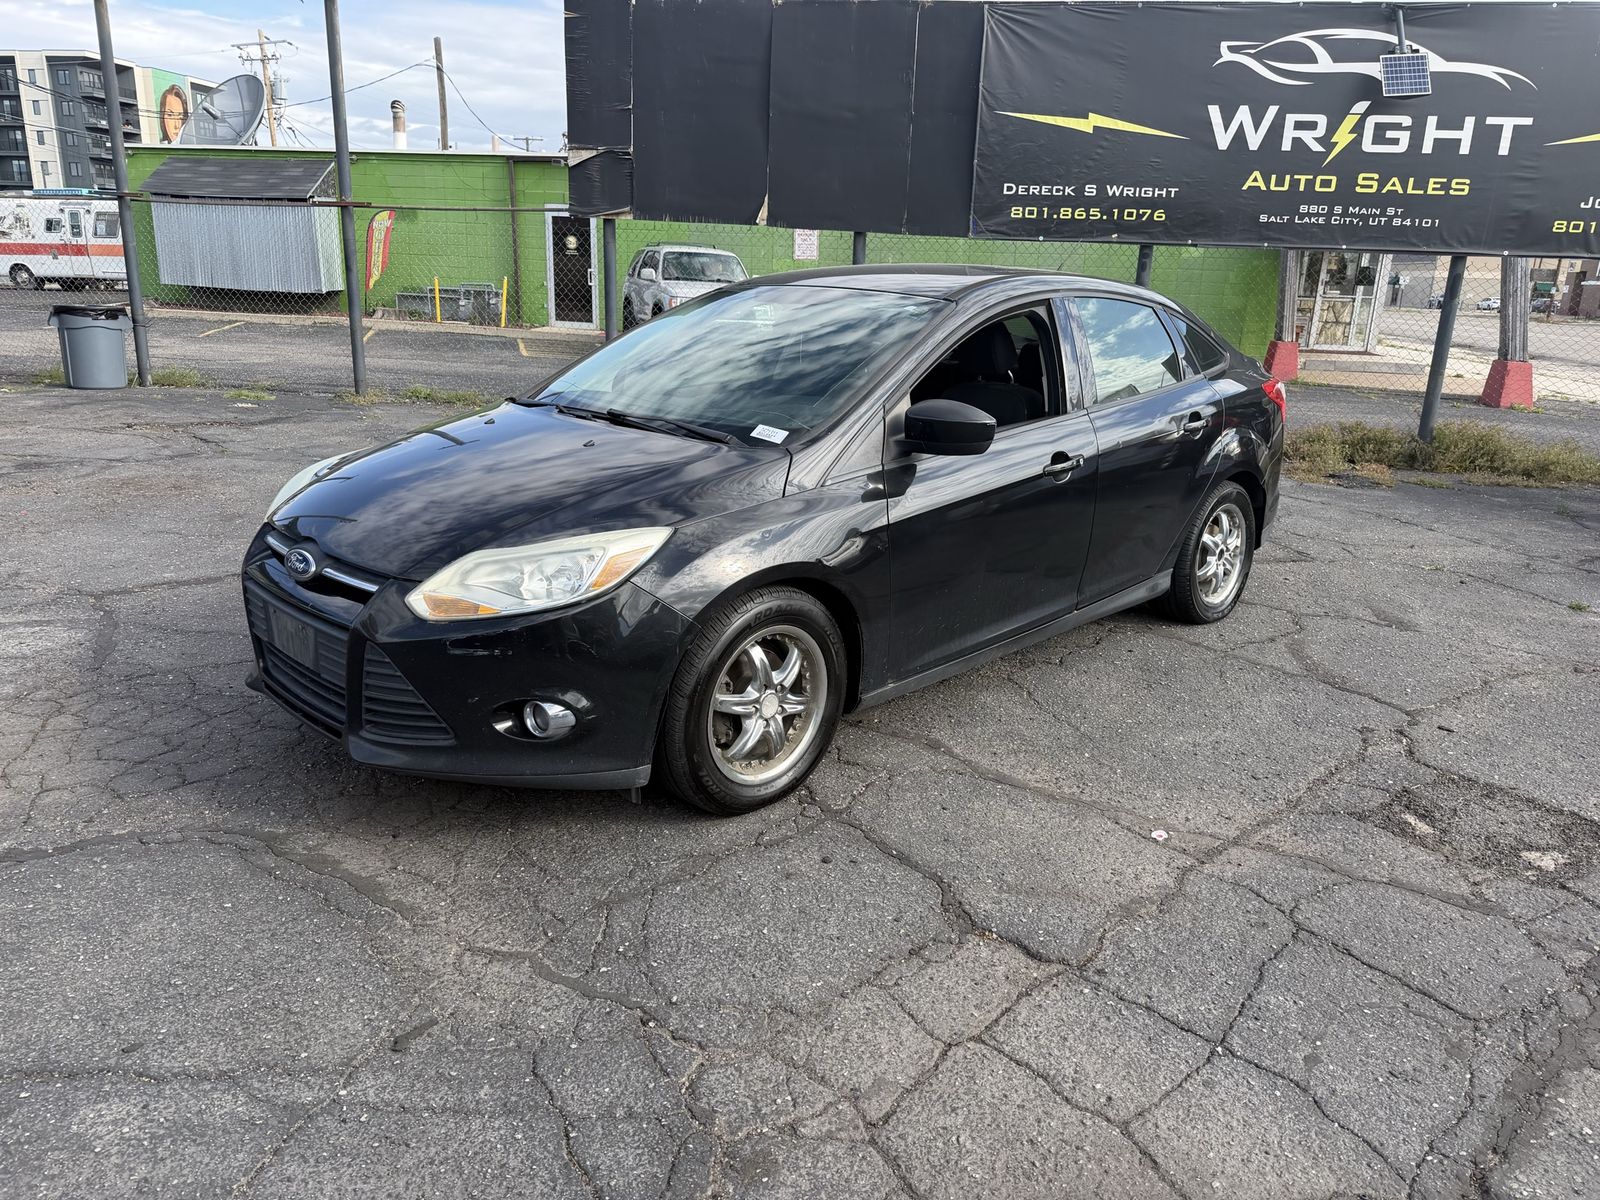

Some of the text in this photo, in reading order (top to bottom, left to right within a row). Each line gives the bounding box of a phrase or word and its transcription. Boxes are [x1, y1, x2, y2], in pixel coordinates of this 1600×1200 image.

[1207, 101, 1534, 167] WRIGHT
[1003, 183, 1180, 198] DERECK S WRIGHT
[1242, 170, 1471, 196] AUTO SALES
[1010, 206, 1166, 221] 801.865.1076
[1299, 204, 1404, 215] 880 S MAIN ST
[1259, 214, 1440, 227] SALT LAKE CITY, UT 84101
[1552, 220, 1597, 234] 801
[287, 552, 306, 572] Ford
